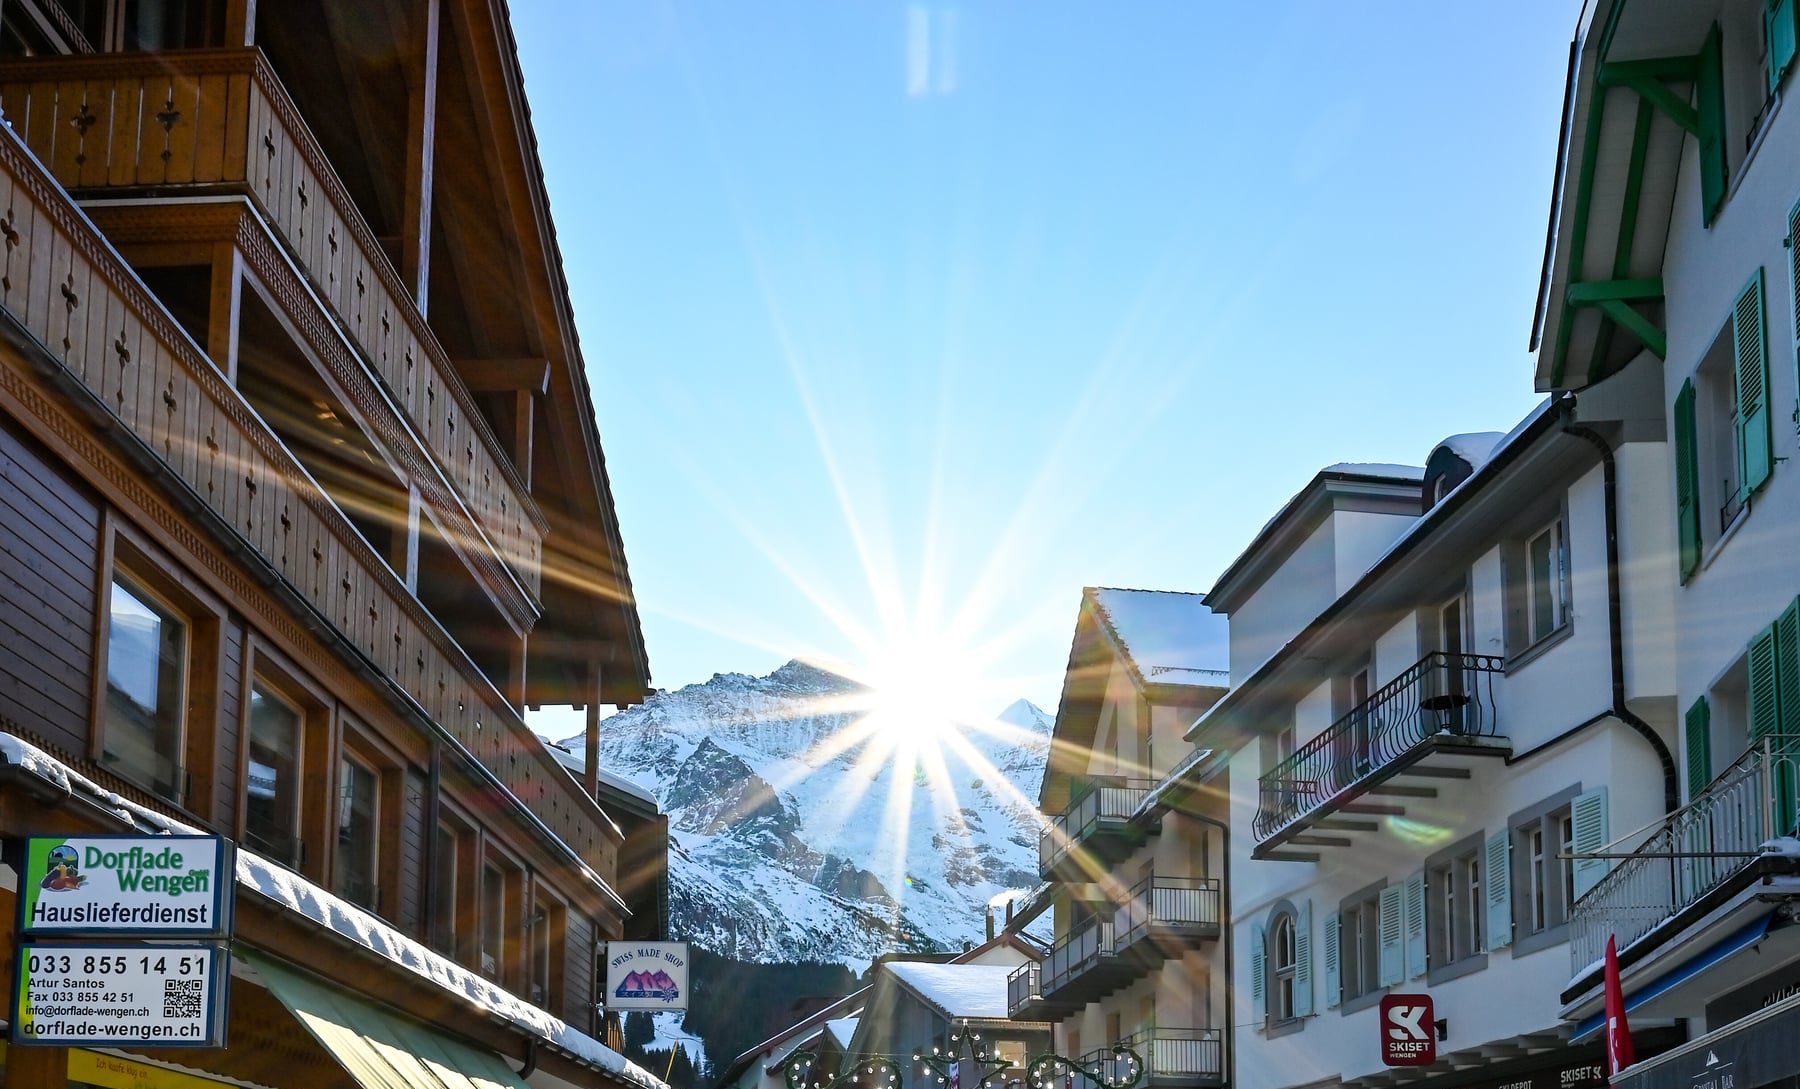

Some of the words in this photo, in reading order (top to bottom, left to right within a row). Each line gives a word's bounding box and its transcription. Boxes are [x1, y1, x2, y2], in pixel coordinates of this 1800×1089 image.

[84, 846, 183, 869] Dorflade
[117, 869, 209, 896] Wengen
[31, 902, 207, 924] Hauslieferdienst
[28, 955, 72, 974] 033
[83, 955, 127, 975] 855
[140, 956, 167, 975] 14
[179, 956, 204, 975] 51
[611, 951, 634, 968] SWISS
[637, 948, 661, 958] MADE
[664, 952, 684, 968] SHOP
[27, 978, 59, 988] Artur
[62, 978, 105, 989] Santos
[27, 992, 48, 1002] Fax
[52, 992, 73, 1002] 033
[77, 992, 99, 1002] 855
[102, 993, 117, 1003] 42
[120, 993, 134, 1003] 51
[25, 1004, 150, 1018] info@dorflade-wengen.ch
[24, 1021, 200, 1040] dorflade-wengen.ch
[1389, 1042, 1430, 1052] SKISET
[1560, 1066, 1592, 1083] SKISET
